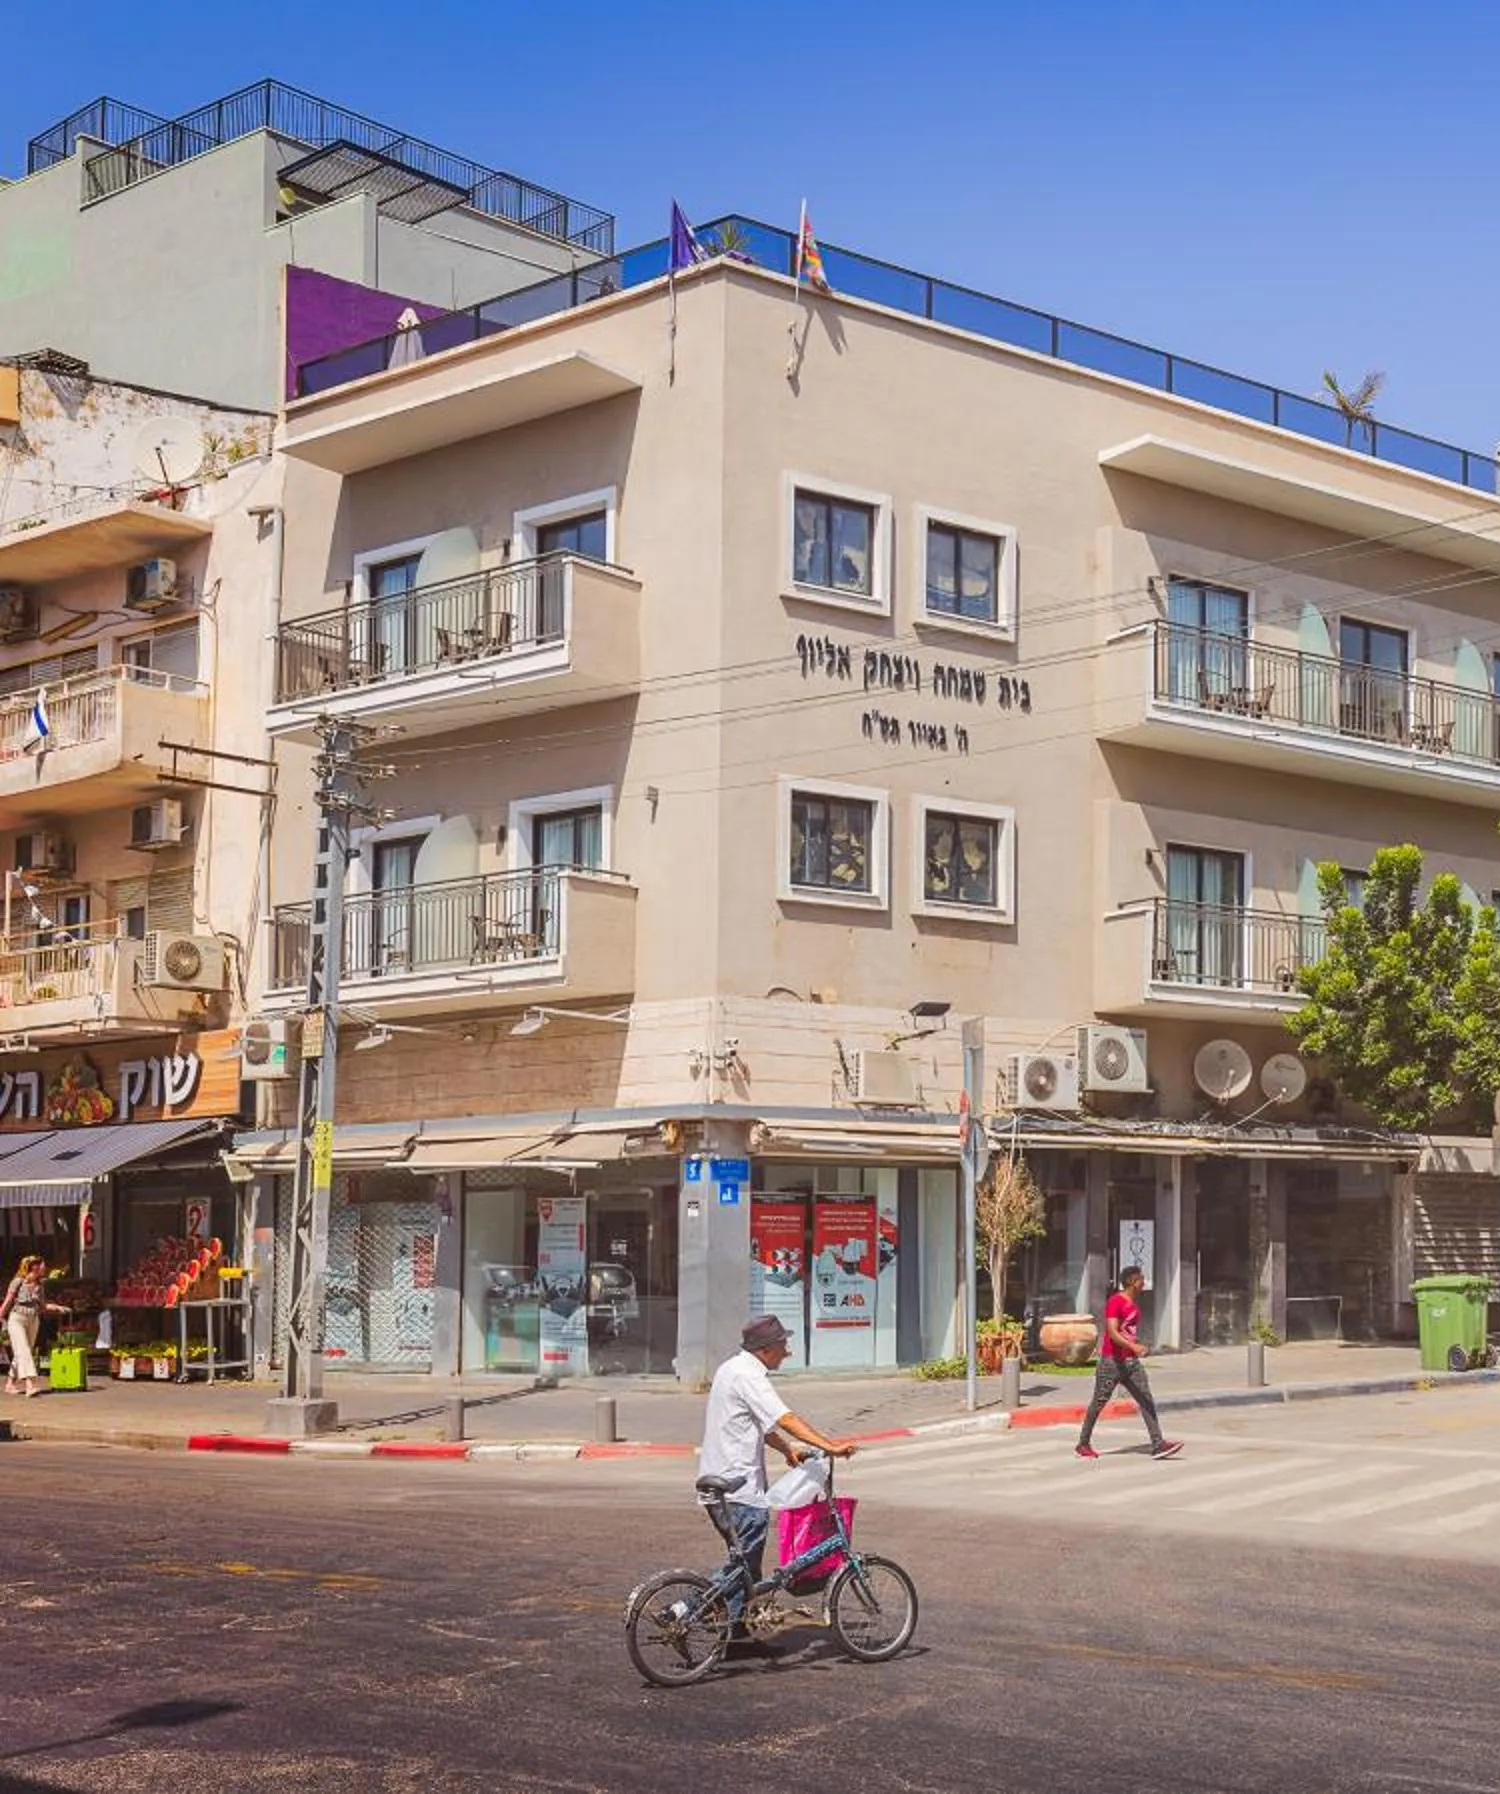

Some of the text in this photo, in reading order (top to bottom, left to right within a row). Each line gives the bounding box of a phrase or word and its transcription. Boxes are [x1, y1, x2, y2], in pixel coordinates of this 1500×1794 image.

[863, 648, 921, 694] ויצחק
[932, 661, 987, 705] שמחה
[997, 675, 1032, 714] בית
[118, 1052, 199, 1120] שוק
